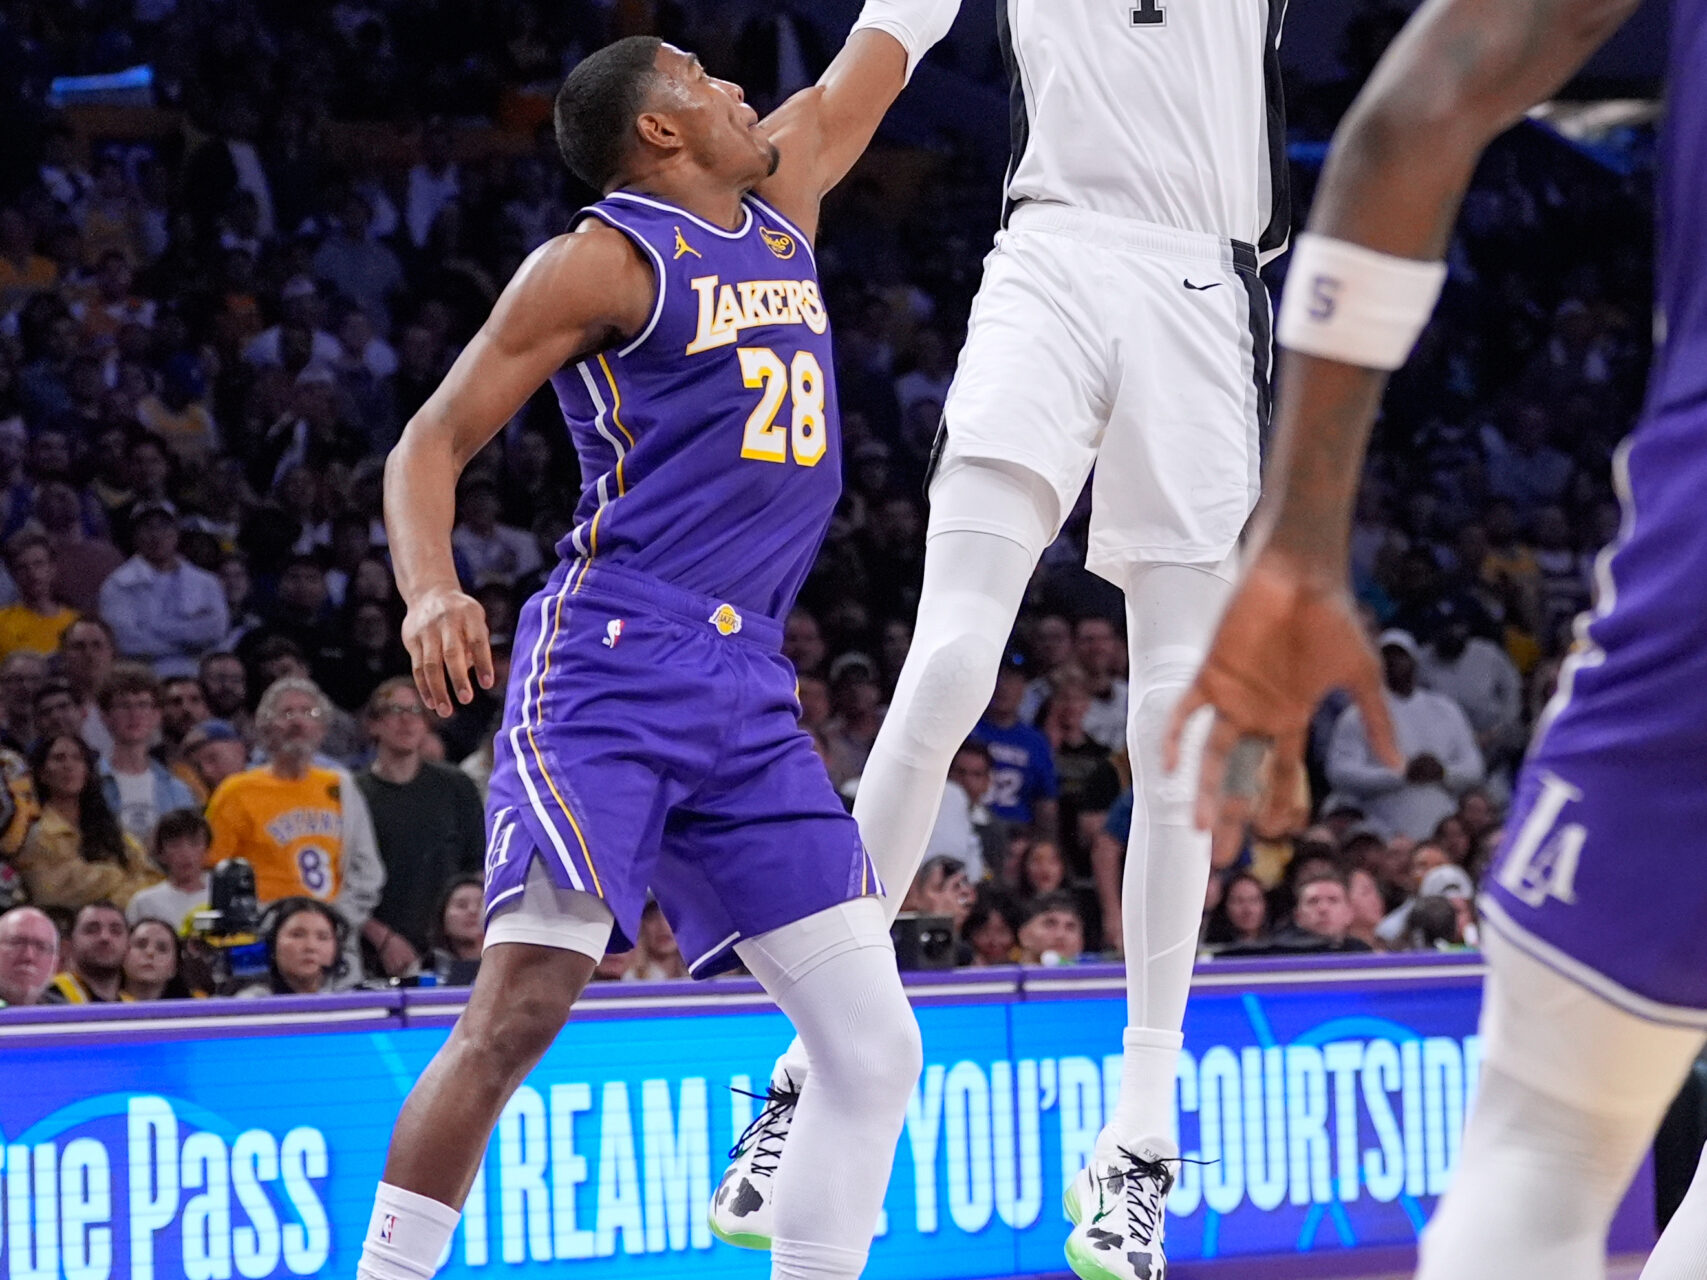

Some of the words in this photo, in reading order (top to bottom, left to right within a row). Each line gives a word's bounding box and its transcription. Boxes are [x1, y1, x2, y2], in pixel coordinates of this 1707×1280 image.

[686, 275, 827, 356] LAKERS
[736, 347, 827, 467] 28
[297, 847, 334, 898] 8
[1492, 770, 1588, 909] LA
[0, 1137, 113, 1280] ue
[127, 1094, 330, 1280] Pass
[1166, 1034, 1488, 1217] COURTSID
